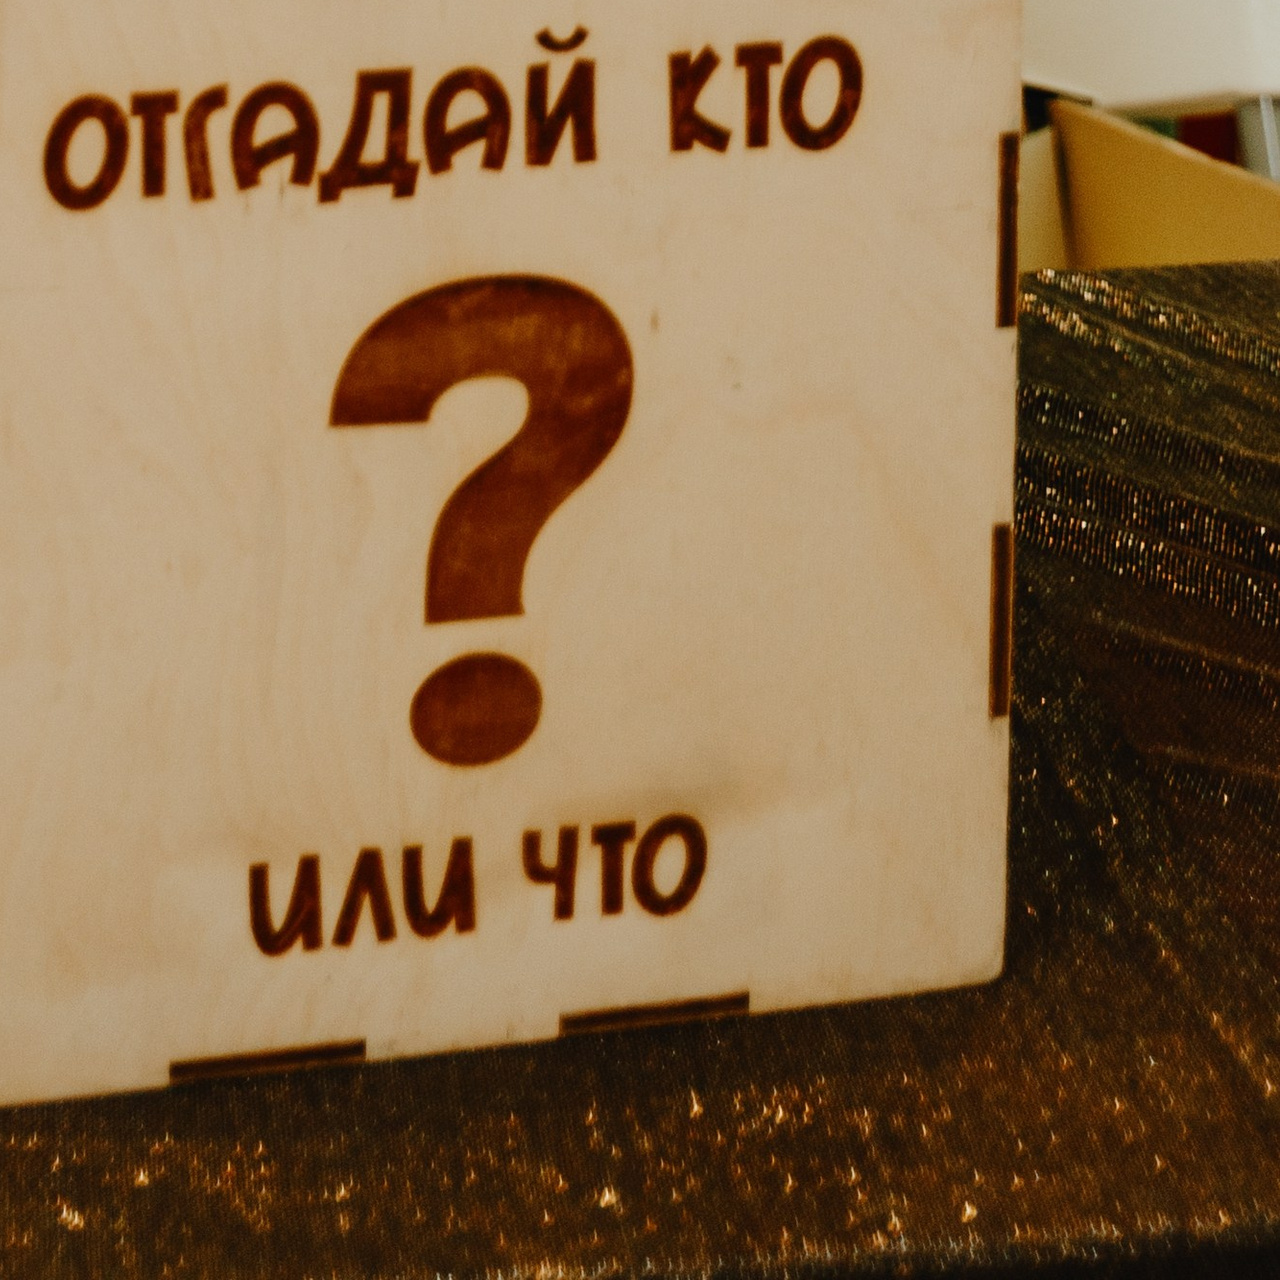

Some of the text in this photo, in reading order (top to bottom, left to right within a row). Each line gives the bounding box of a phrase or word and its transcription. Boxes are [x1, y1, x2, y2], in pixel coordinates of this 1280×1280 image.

[43, 24, 864, 213] ОТГАДАЙ КТО
[328, 273, 634, 769] ?
[248, 810, 708, 958] ИЛИ ЧТО
